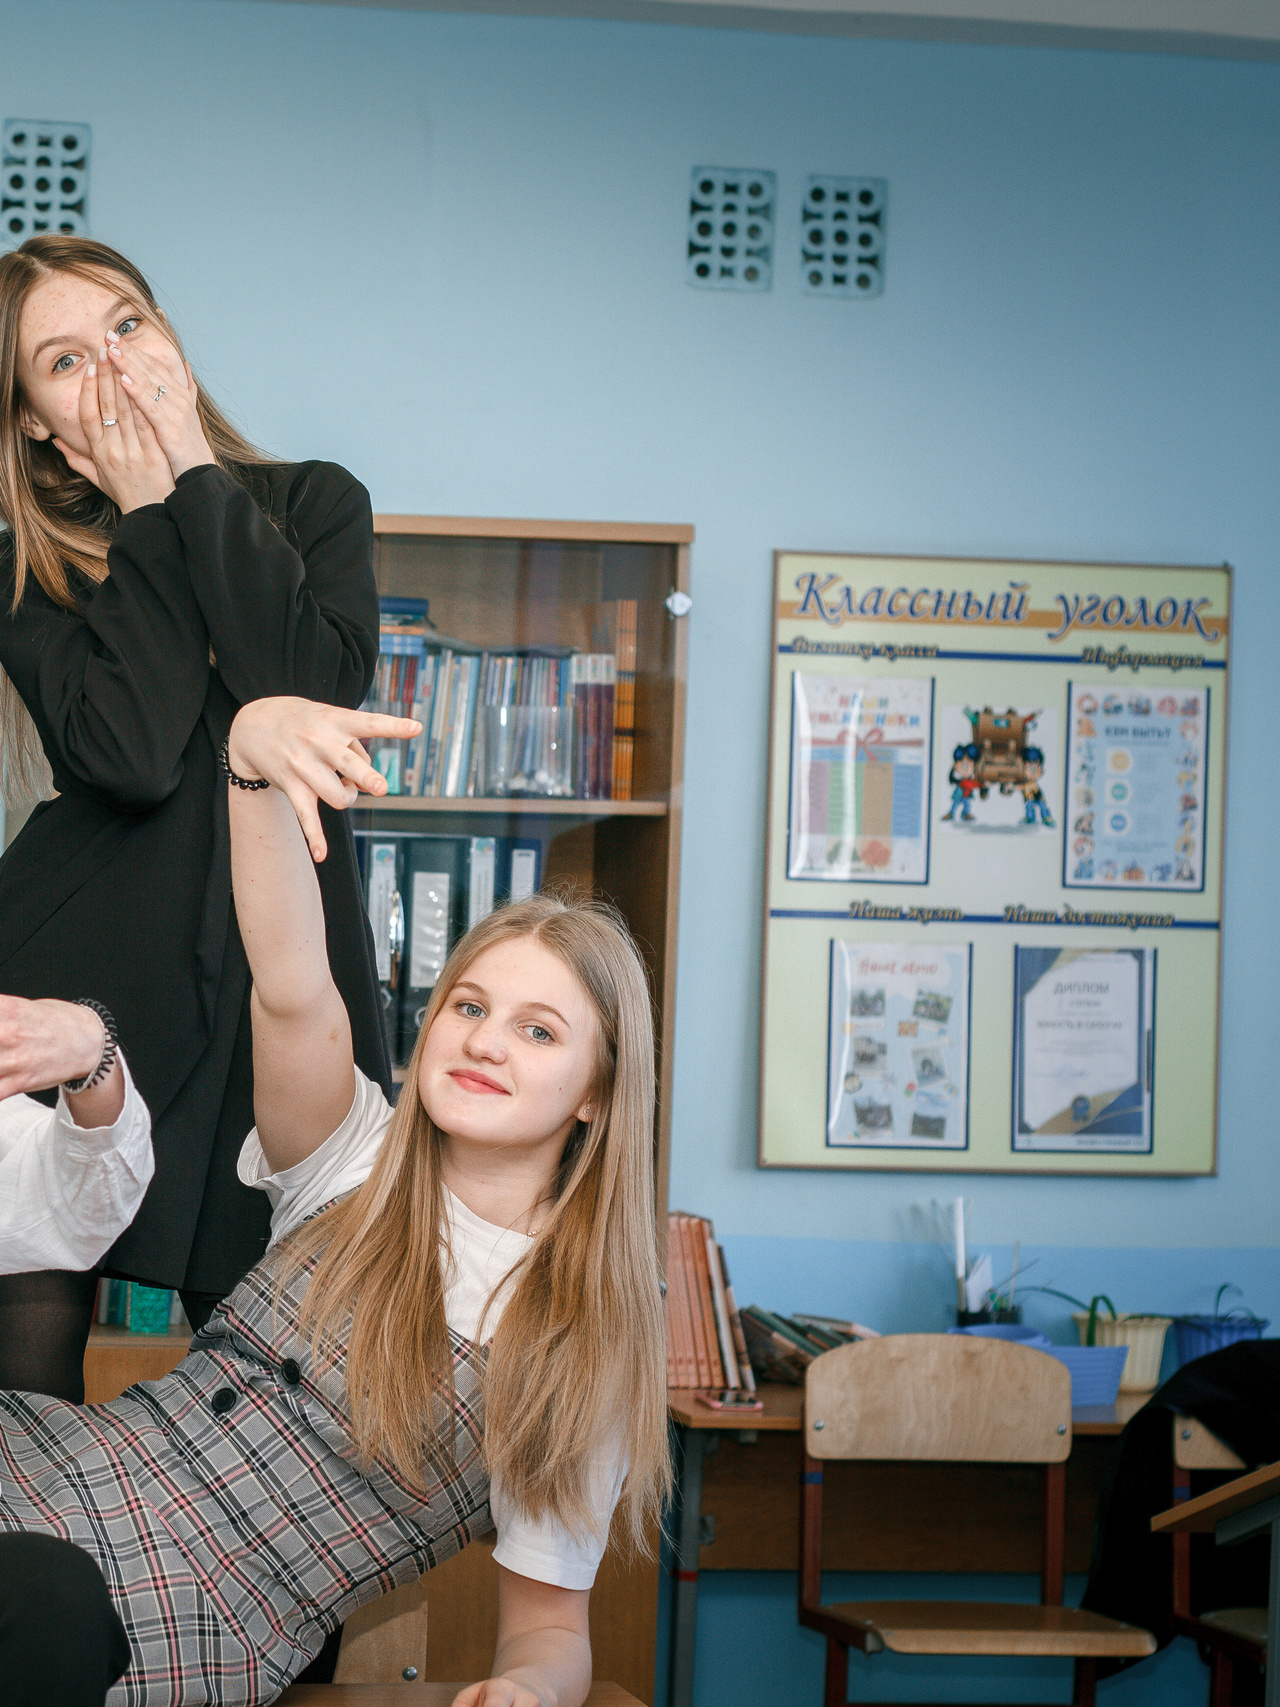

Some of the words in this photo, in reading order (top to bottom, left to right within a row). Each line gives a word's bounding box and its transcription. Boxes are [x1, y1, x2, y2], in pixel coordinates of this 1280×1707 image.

[794, 571, 1029, 625] Классный
[1047, 593, 1219, 642] уголок
[879, 640, 939, 662] класса
[1082, 645, 1205, 673] Информация
[848, 900, 902, 920] Наша
[905, 904, 964, 926] жизнь
[1003, 903, 1057, 924] Наши
[1060, 902, 1175, 931] достижения
[1053, 982, 1111, 995] ДИПЛОМ
